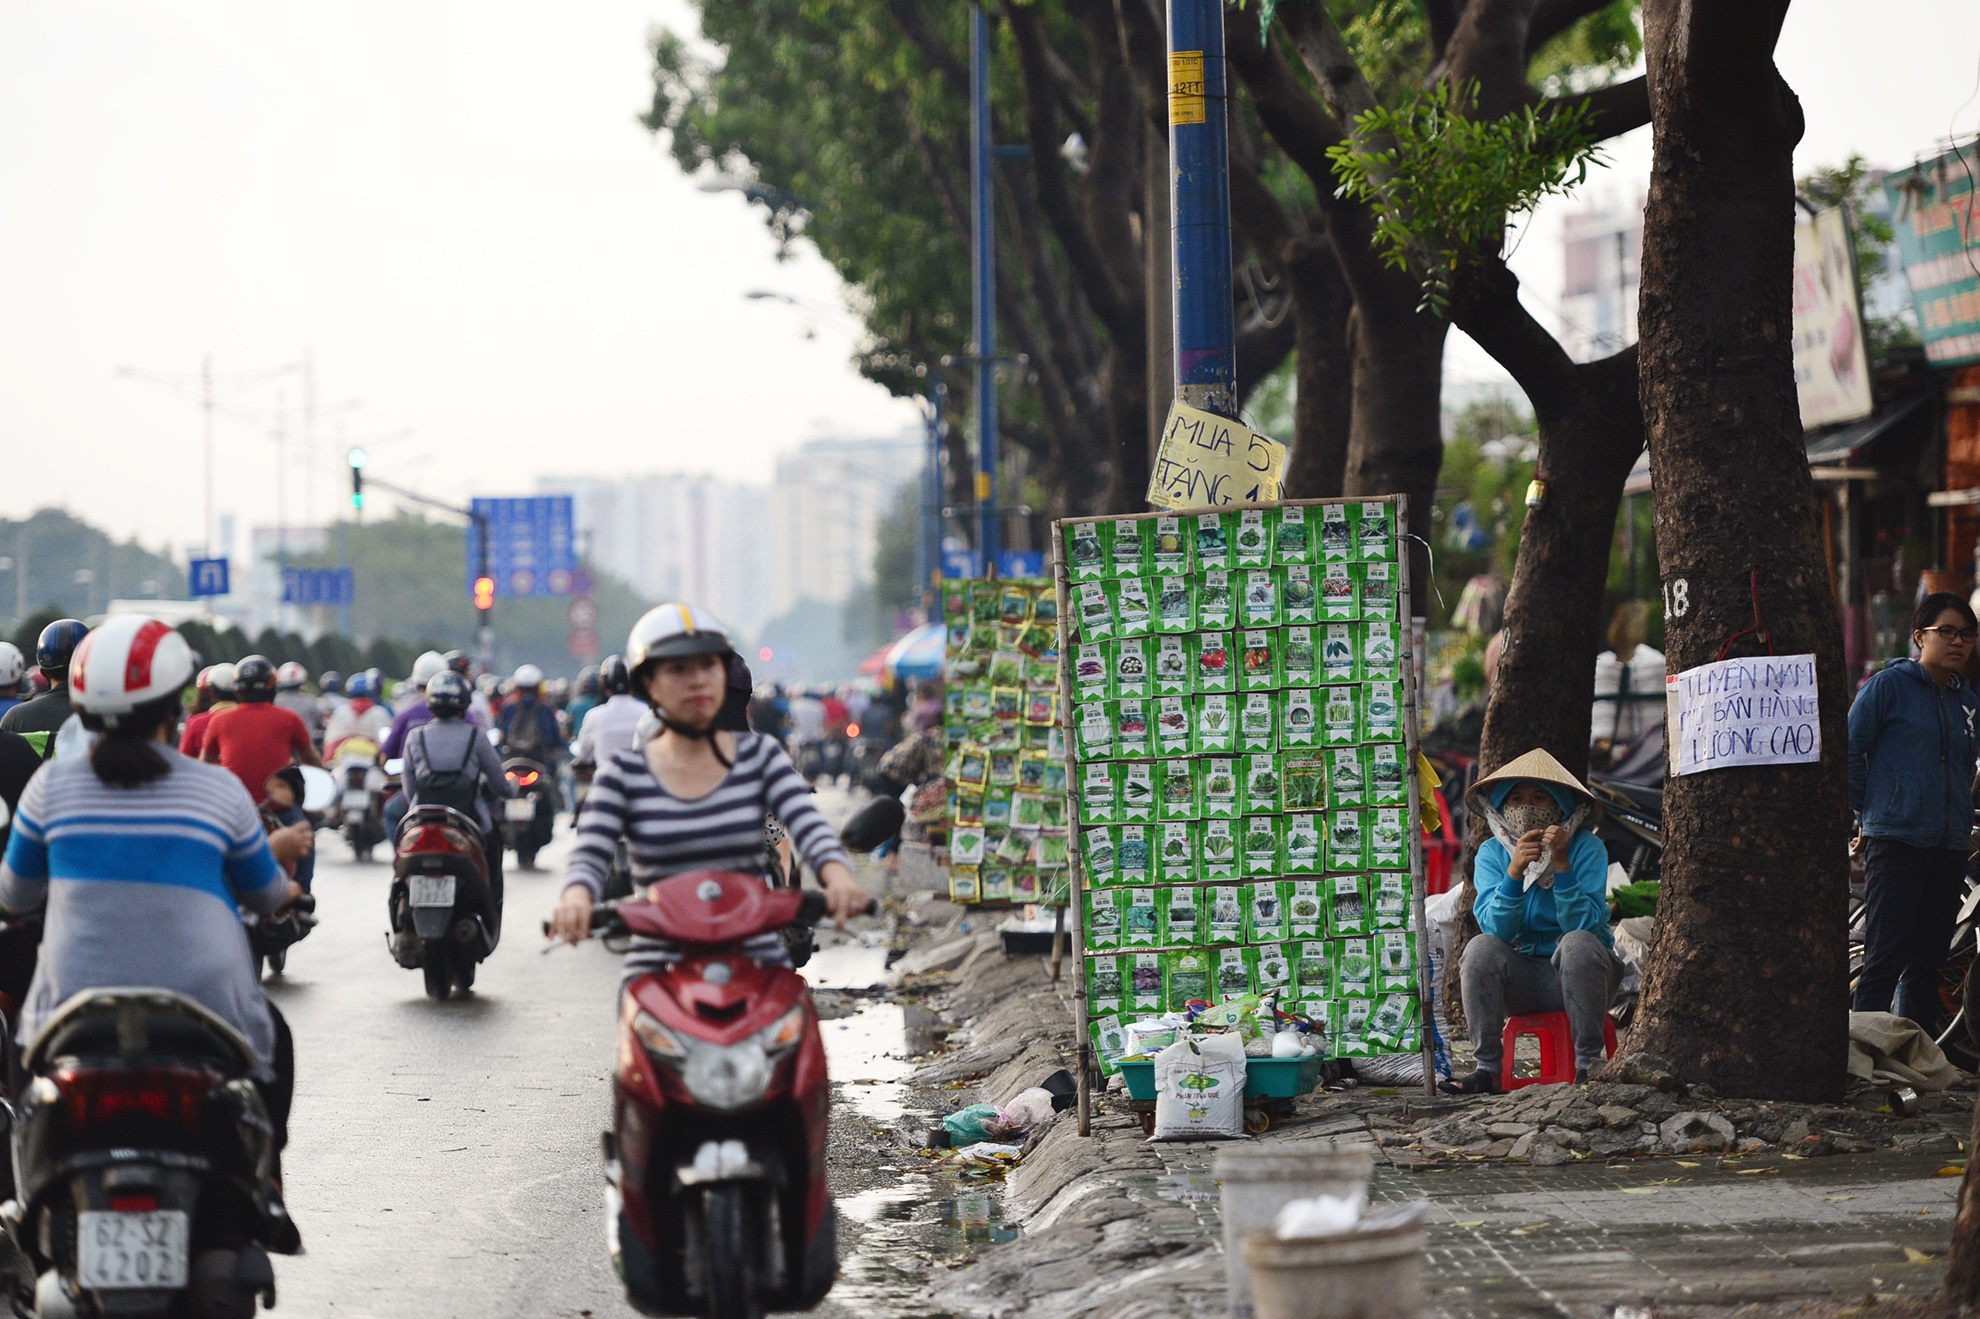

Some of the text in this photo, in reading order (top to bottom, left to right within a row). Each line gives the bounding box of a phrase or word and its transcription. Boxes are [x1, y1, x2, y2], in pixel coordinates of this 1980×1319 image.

[1170, 416, 1236, 457] MUA
[1247, 433, 1272, 472] 5
[1161, 456, 1233, 506] TẶNG
[1663, 578, 1690, 620] 18
[1765, 661, 1814, 689] NAM
[1714, 691, 1752, 722] BÁN
[1759, 688, 1816, 718] HÀNG
[1770, 723, 1814, 756] CAO
